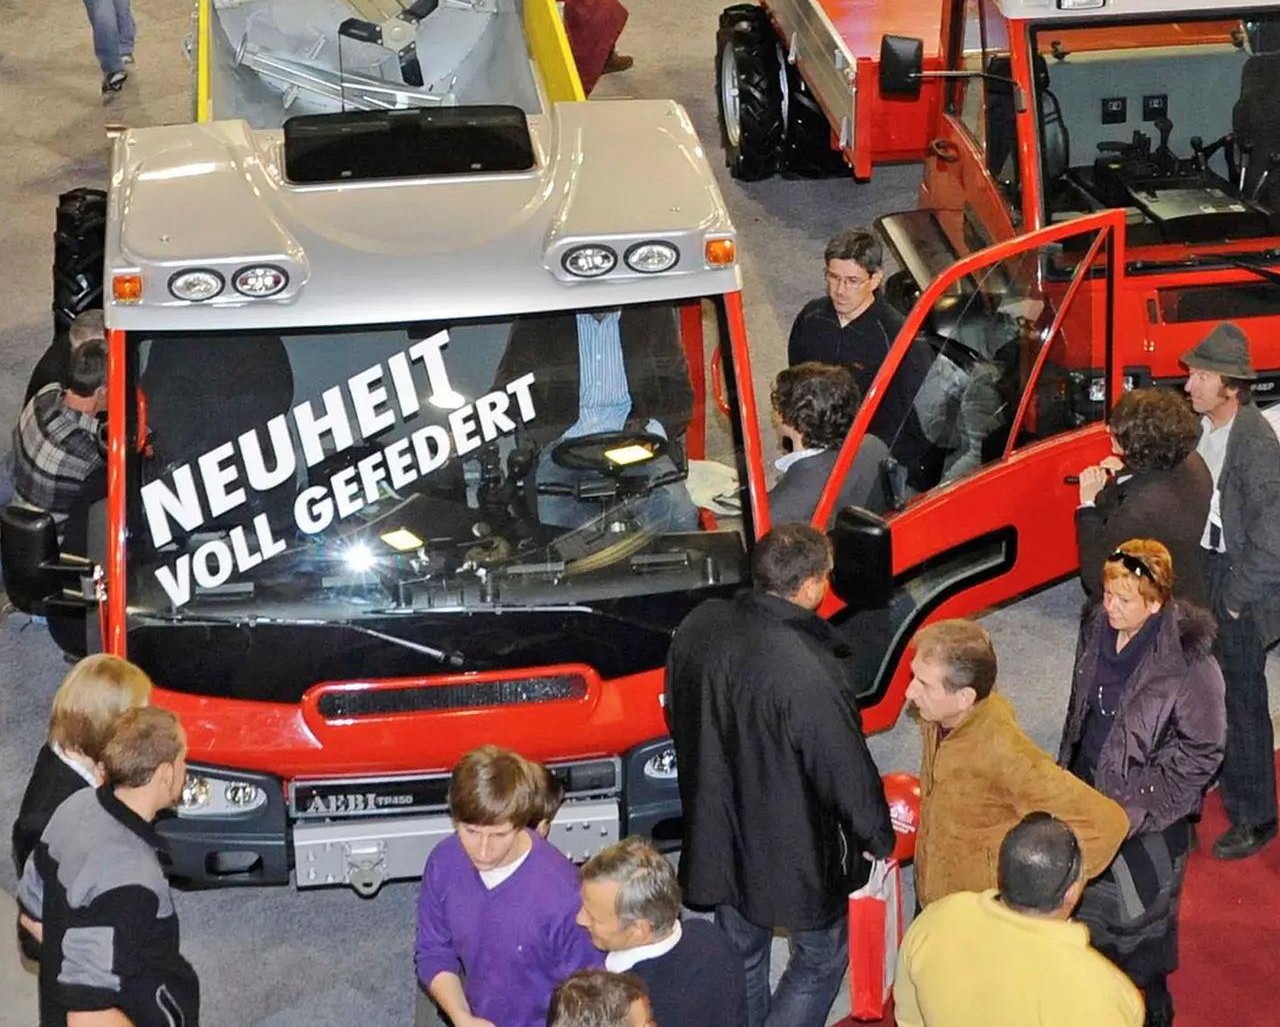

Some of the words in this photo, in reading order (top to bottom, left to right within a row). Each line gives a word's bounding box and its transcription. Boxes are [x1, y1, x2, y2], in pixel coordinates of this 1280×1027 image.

[140, 329, 466, 550] NEUHEIT
[293, 372, 537, 535] GEFEDERT
[154, 512, 287, 608] VOLL
[305, 792, 378, 813] AEBI
[377, 795, 414, 807] TP450
